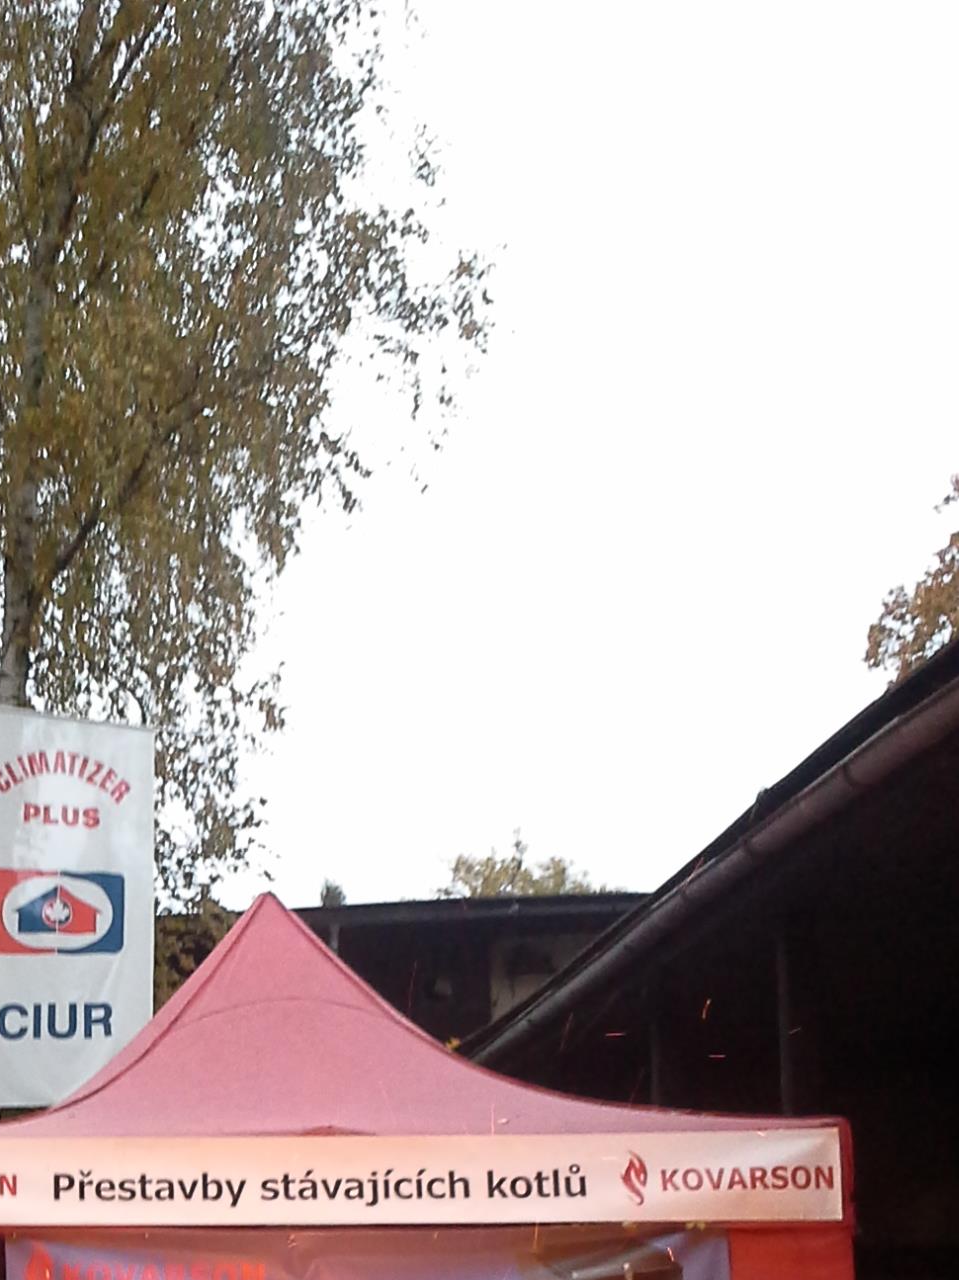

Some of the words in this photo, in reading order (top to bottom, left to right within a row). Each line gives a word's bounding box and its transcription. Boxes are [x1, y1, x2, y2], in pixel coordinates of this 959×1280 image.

[22, 802, 100, 828] PLUS
[53, 1170, 246, 1207] Přestavby
[260, 1167, 471, 1207] stávajících
[486, 1164, 588, 1199] kotlů
[660, 1165, 834, 1193] KOVARSON
